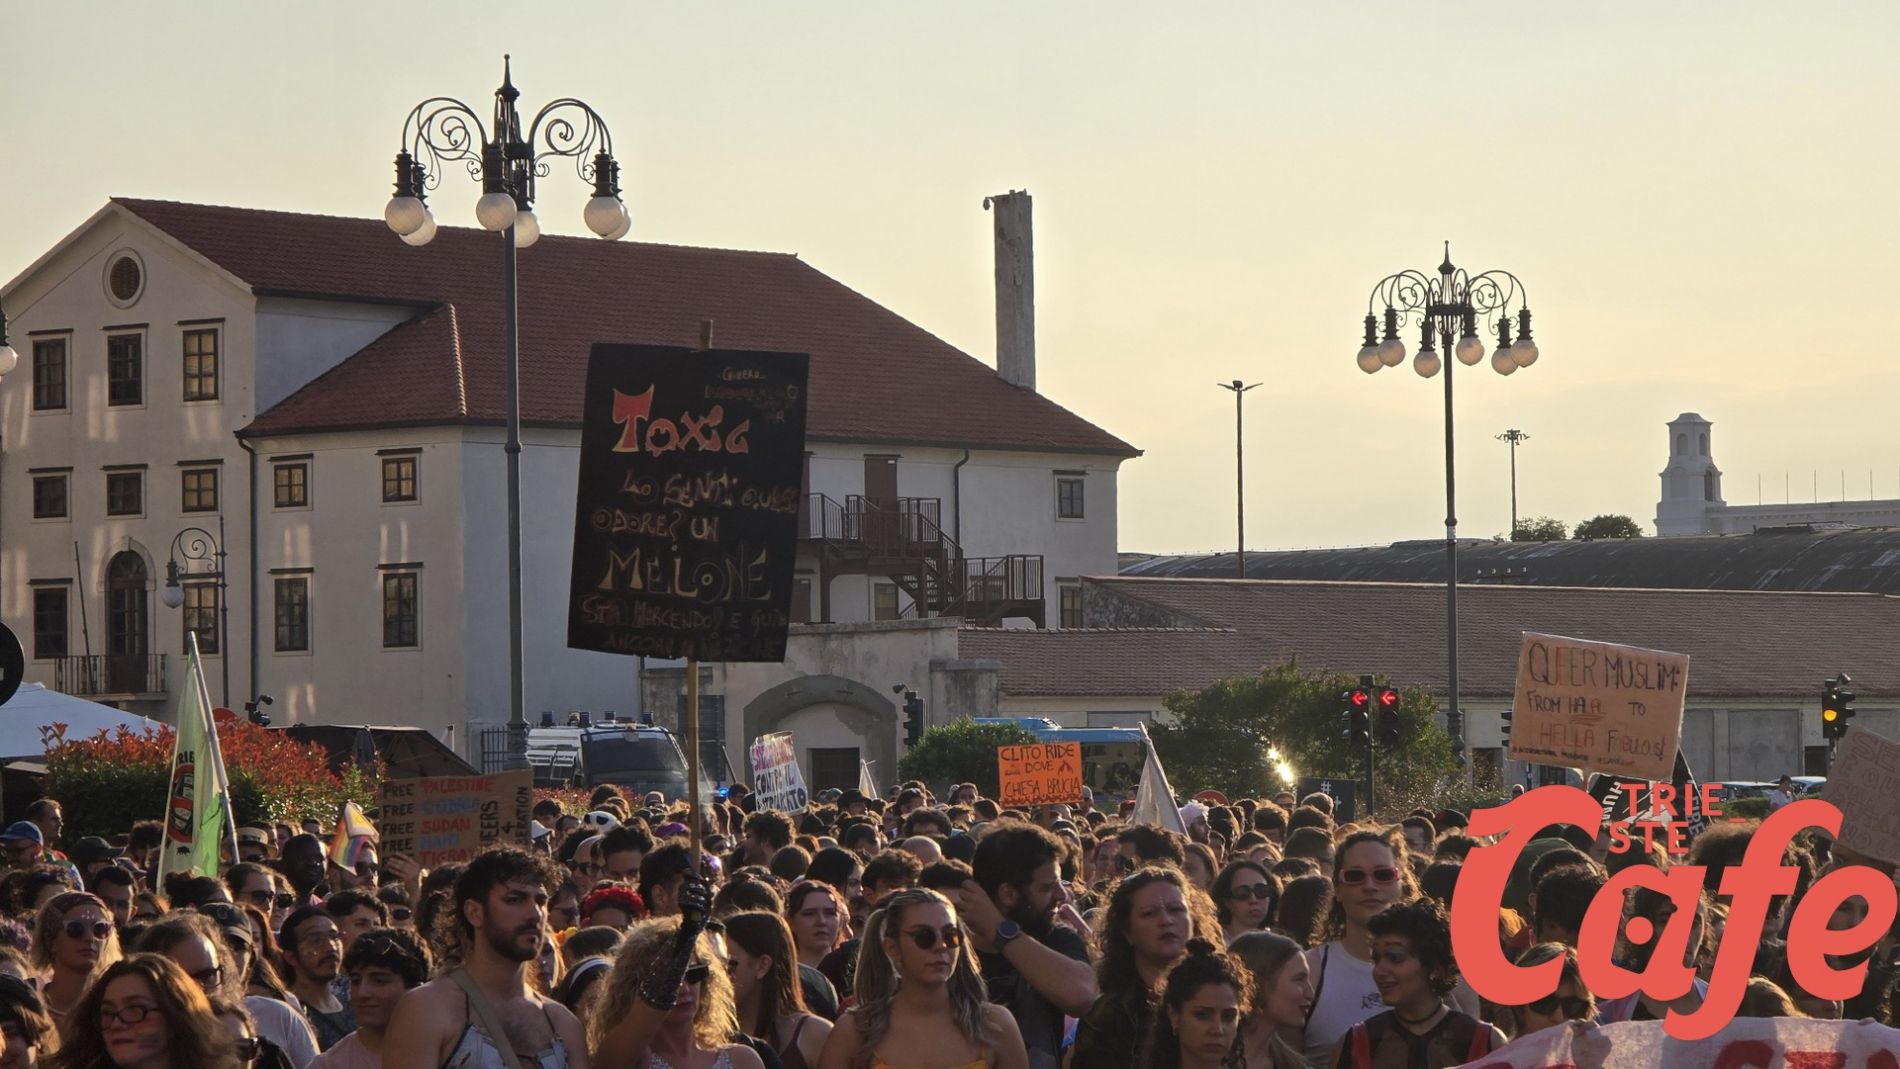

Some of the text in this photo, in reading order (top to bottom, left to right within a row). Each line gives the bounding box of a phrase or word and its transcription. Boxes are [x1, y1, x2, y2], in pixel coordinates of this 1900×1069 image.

[597, 546, 772, 602] MELONE
[1529, 642, 1597, 688] QUEER
[1527, 689, 1561, 714] FROM
[1628, 701, 1646, 716] TO
[1540, 723, 1595, 748] HELLA
[1001, 743, 1075, 762] CLITO RIDE
[1025, 760, 1054, 774] DOVE
[382, 776, 498, 800] FREE PALESTINE
[1005, 777, 1082, 798] CHIESA BRUCIA
[382, 802, 415, 819] FREE
[382, 815, 471, 838] FREE SUDAN
[382, 838, 413, 855] FREE
